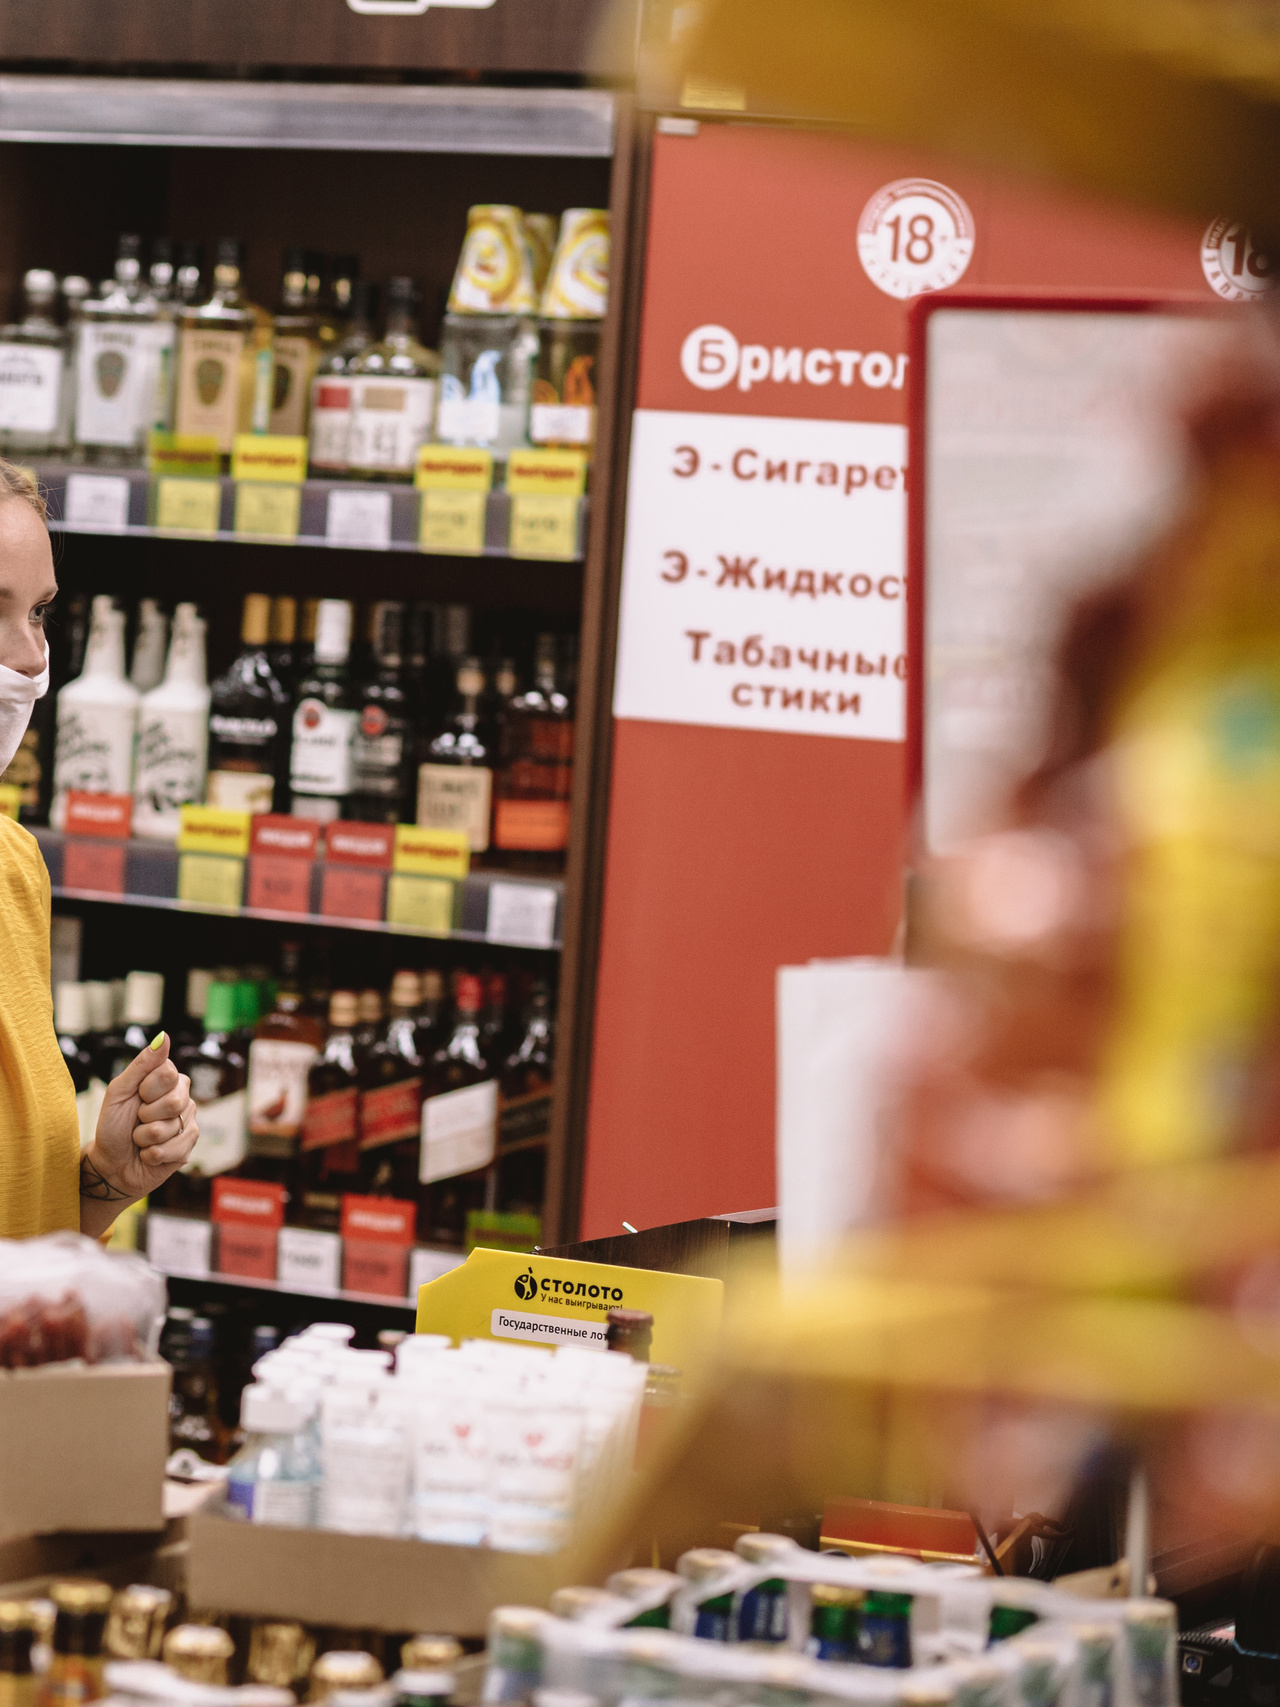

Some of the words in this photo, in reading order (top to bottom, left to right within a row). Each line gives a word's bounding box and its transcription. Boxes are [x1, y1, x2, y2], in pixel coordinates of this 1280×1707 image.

[660, 549, 908, 600] Э-Жидкос
[731, 683, 862, 717] стики
[540, 1293, 547, 1302] У
[548, 1296, 564, 1305] нас
[499, 1315, 588, 1339] Государственные
